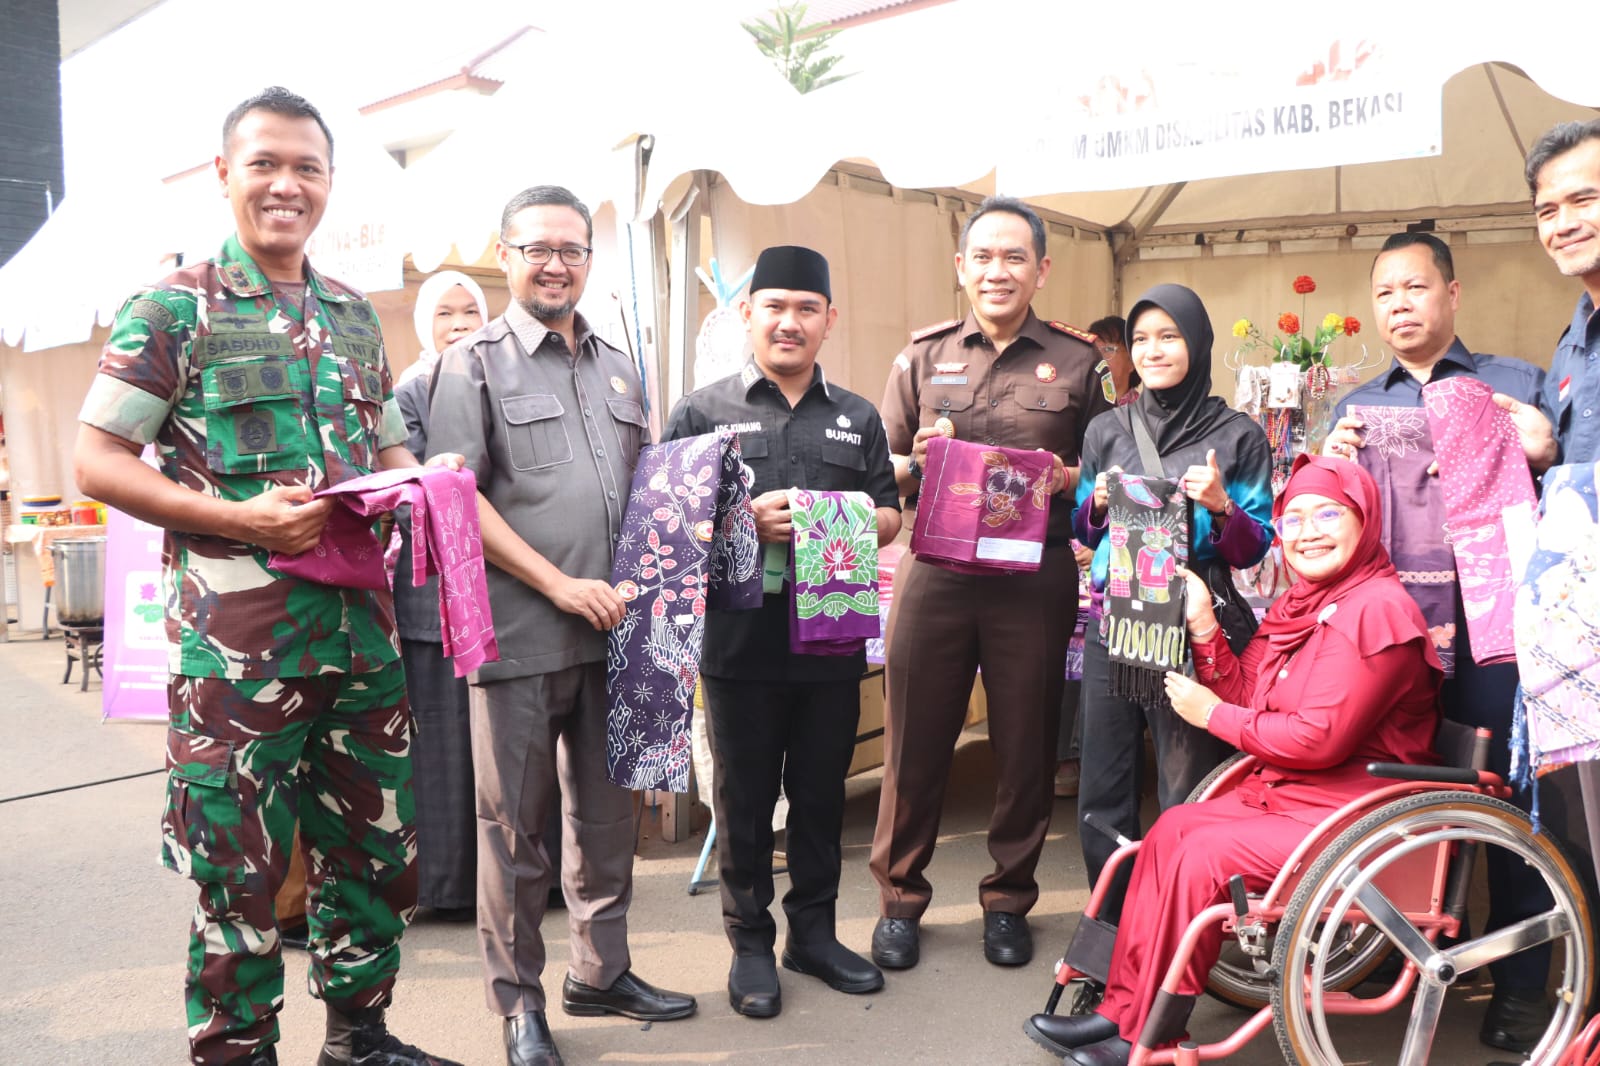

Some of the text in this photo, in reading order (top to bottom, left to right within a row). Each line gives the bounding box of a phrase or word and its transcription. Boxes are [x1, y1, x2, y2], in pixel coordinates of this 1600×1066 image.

[1273, 104, 1320, 136] KAB.
[1329, 91, 1403, 130] BEKASI
[207, 338, 281, 355] SABDHO
[825, 428, 862, 446] BUPATI
